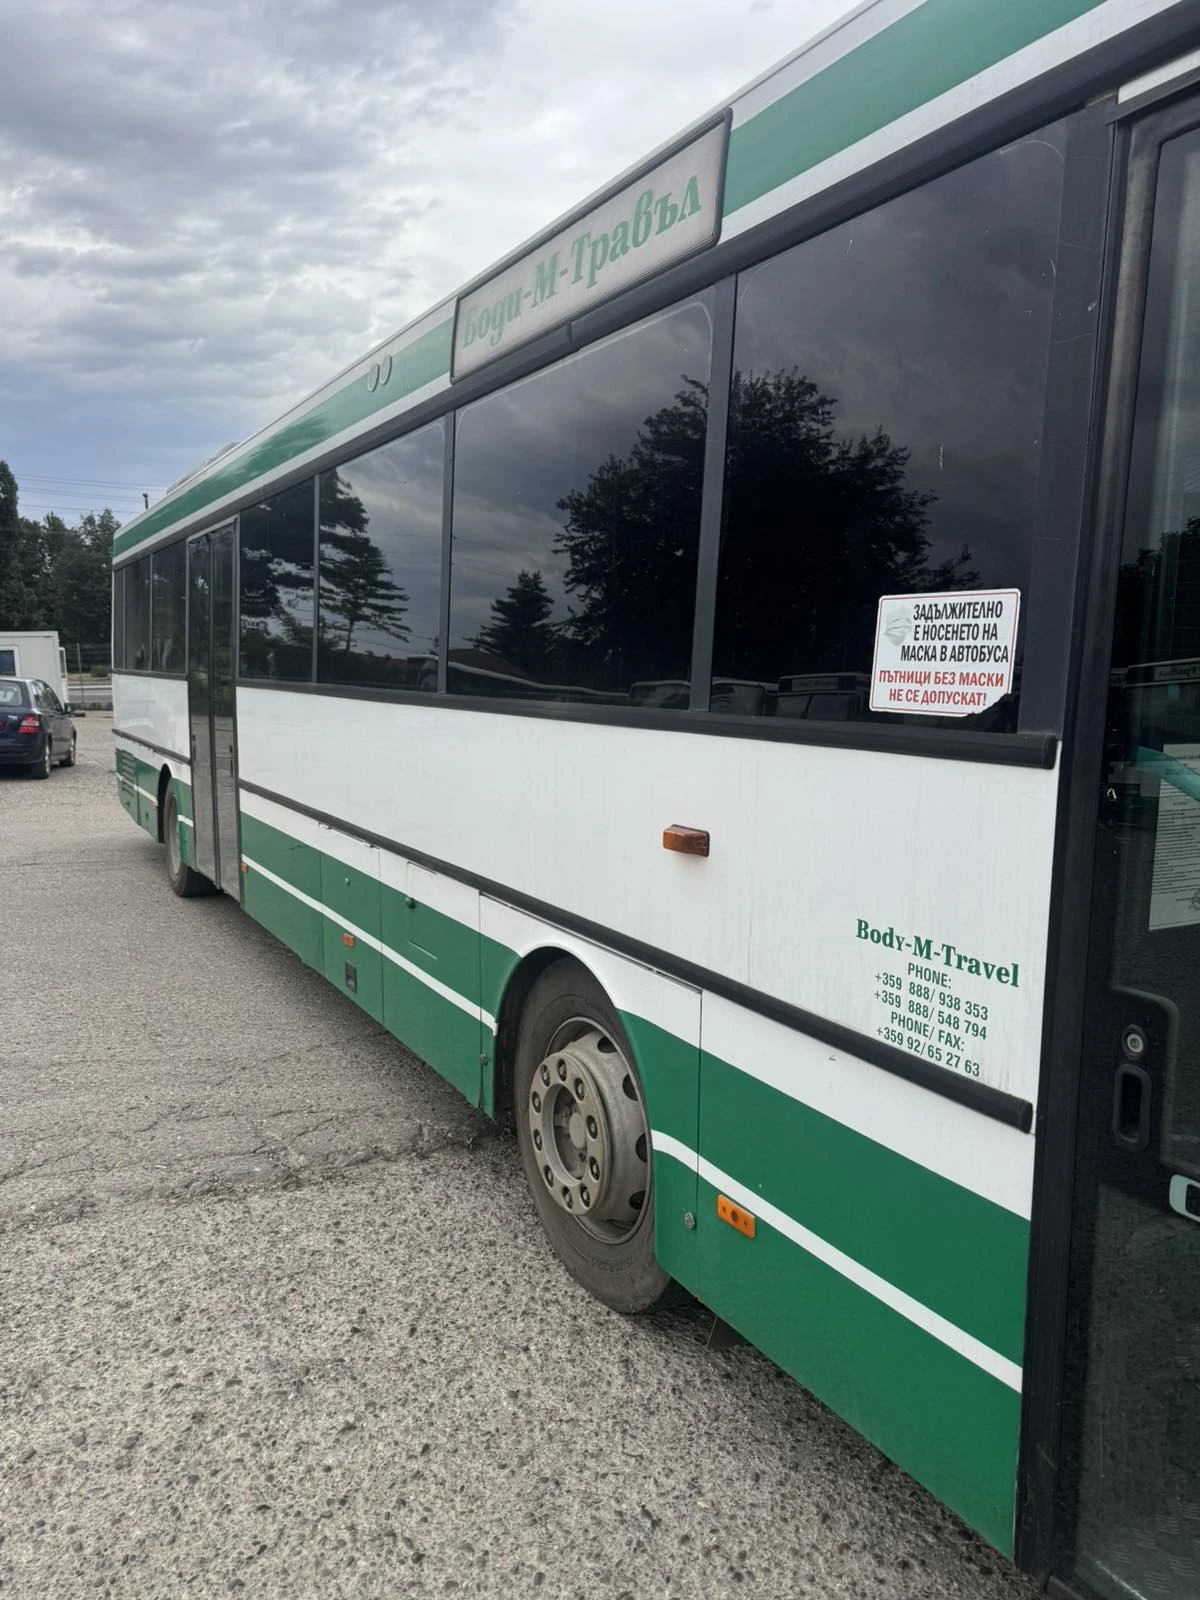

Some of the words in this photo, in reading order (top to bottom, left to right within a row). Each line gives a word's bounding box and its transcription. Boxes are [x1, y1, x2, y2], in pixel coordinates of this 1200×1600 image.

[913, 601, 1003, 623] ЗАДЪЛЖИТЕЛНО
[913, 625, 921, 641] Е
[922, 624, 979, 641] НОСЕНЕТО
[983, 623, 998, 641] НА
[901, 645, 937, 662] МАСКА
[940, 645, 947, 662] В
[950, 645, 1009, 663] АВТОБУСА
[879, 670, 931, 686] ПЪТНИЦИ
[934, 671, 956, 686] БЕЗ
[959, 672, 1004, 688] МАСКИ
[889, 689, 903, 702] НЕ
[906, 689, 920, 703] СЕ
[921, 690, 987, 706] ДОПУСКАТ!
[856, 918, 1019, 987] Body-M-Travel
[907, 962, 952, 989] PHONE:
[875, 972, 902, 990] +359
[909, 982, 935, 1003] 888/
[939, 992, 961, 1011] 938
[964, 1001, 989, 1021] 353
[874, 990, 901, 1008] +359
[908, 1000, 935, 1021] 888/
[937, 1011, 960, 1030] 548
[964, 1020, 987, 1040] 794
[891, 1011, 935, 1041] PHONE/
[938, 1029, 965, 1051] FAX:
[876, 1026, 904, 1045] +359
[946, 1052, 961, 1069] 27
[964, 1060, 980, 1077] 63
